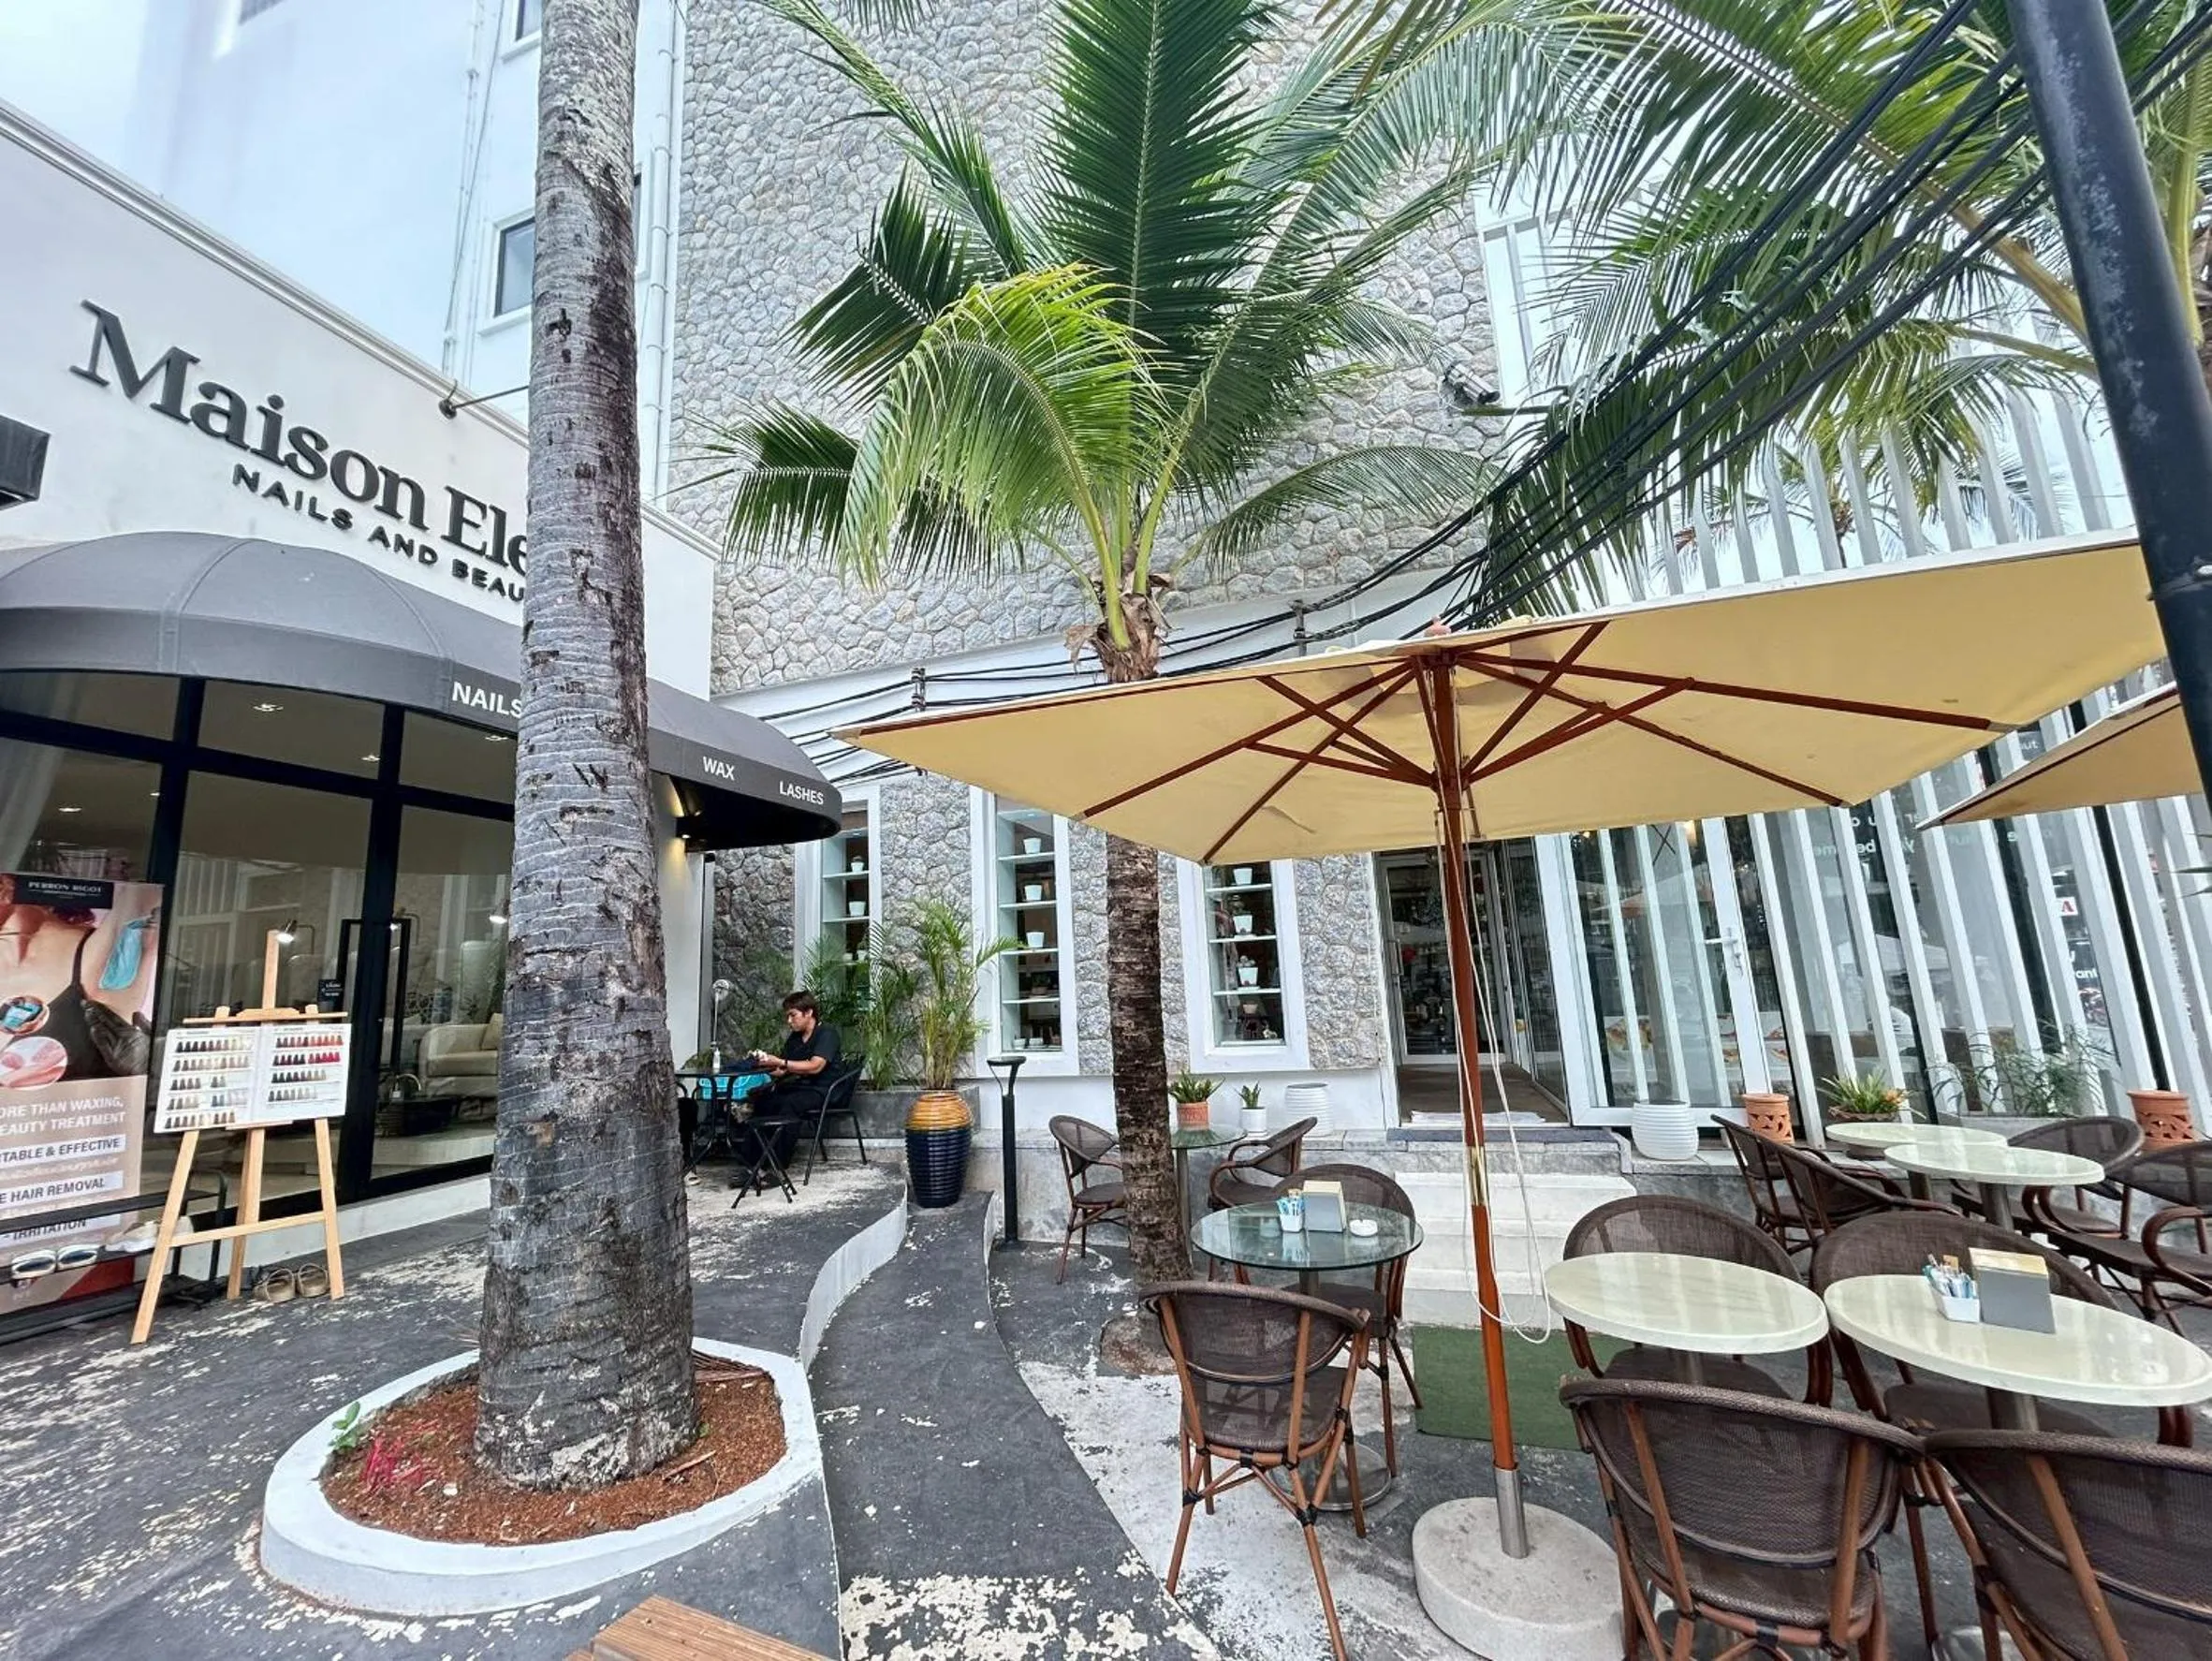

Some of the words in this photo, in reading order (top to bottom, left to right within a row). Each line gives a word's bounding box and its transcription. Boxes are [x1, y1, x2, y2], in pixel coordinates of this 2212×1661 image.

[69, 299, 430, 532] Maison
[232, 463, 354, 531] NAILS
[368, 524, 439, 566] AND
[451, 557, 524, 603] BEAU
[452, 681, 522, 719] NAILS
[702, 756, 735, 781] WAX
[779, 780, 824, 805] LASHES
[0, 1105, 27, 1119] ORE
[30, 1100, 67, 1116] THAN
[0, 1122, 47, 1136] EAUTY
[51, 1111, 126, 1130] TREATMENT
[46, 1145, 56, 1157] &
[58, 1138, 120, 1155] EFFECTIVE
[10, 1186, 44, 1203] HAIR
[47, 1178, 105, 1197] REMOVAL
